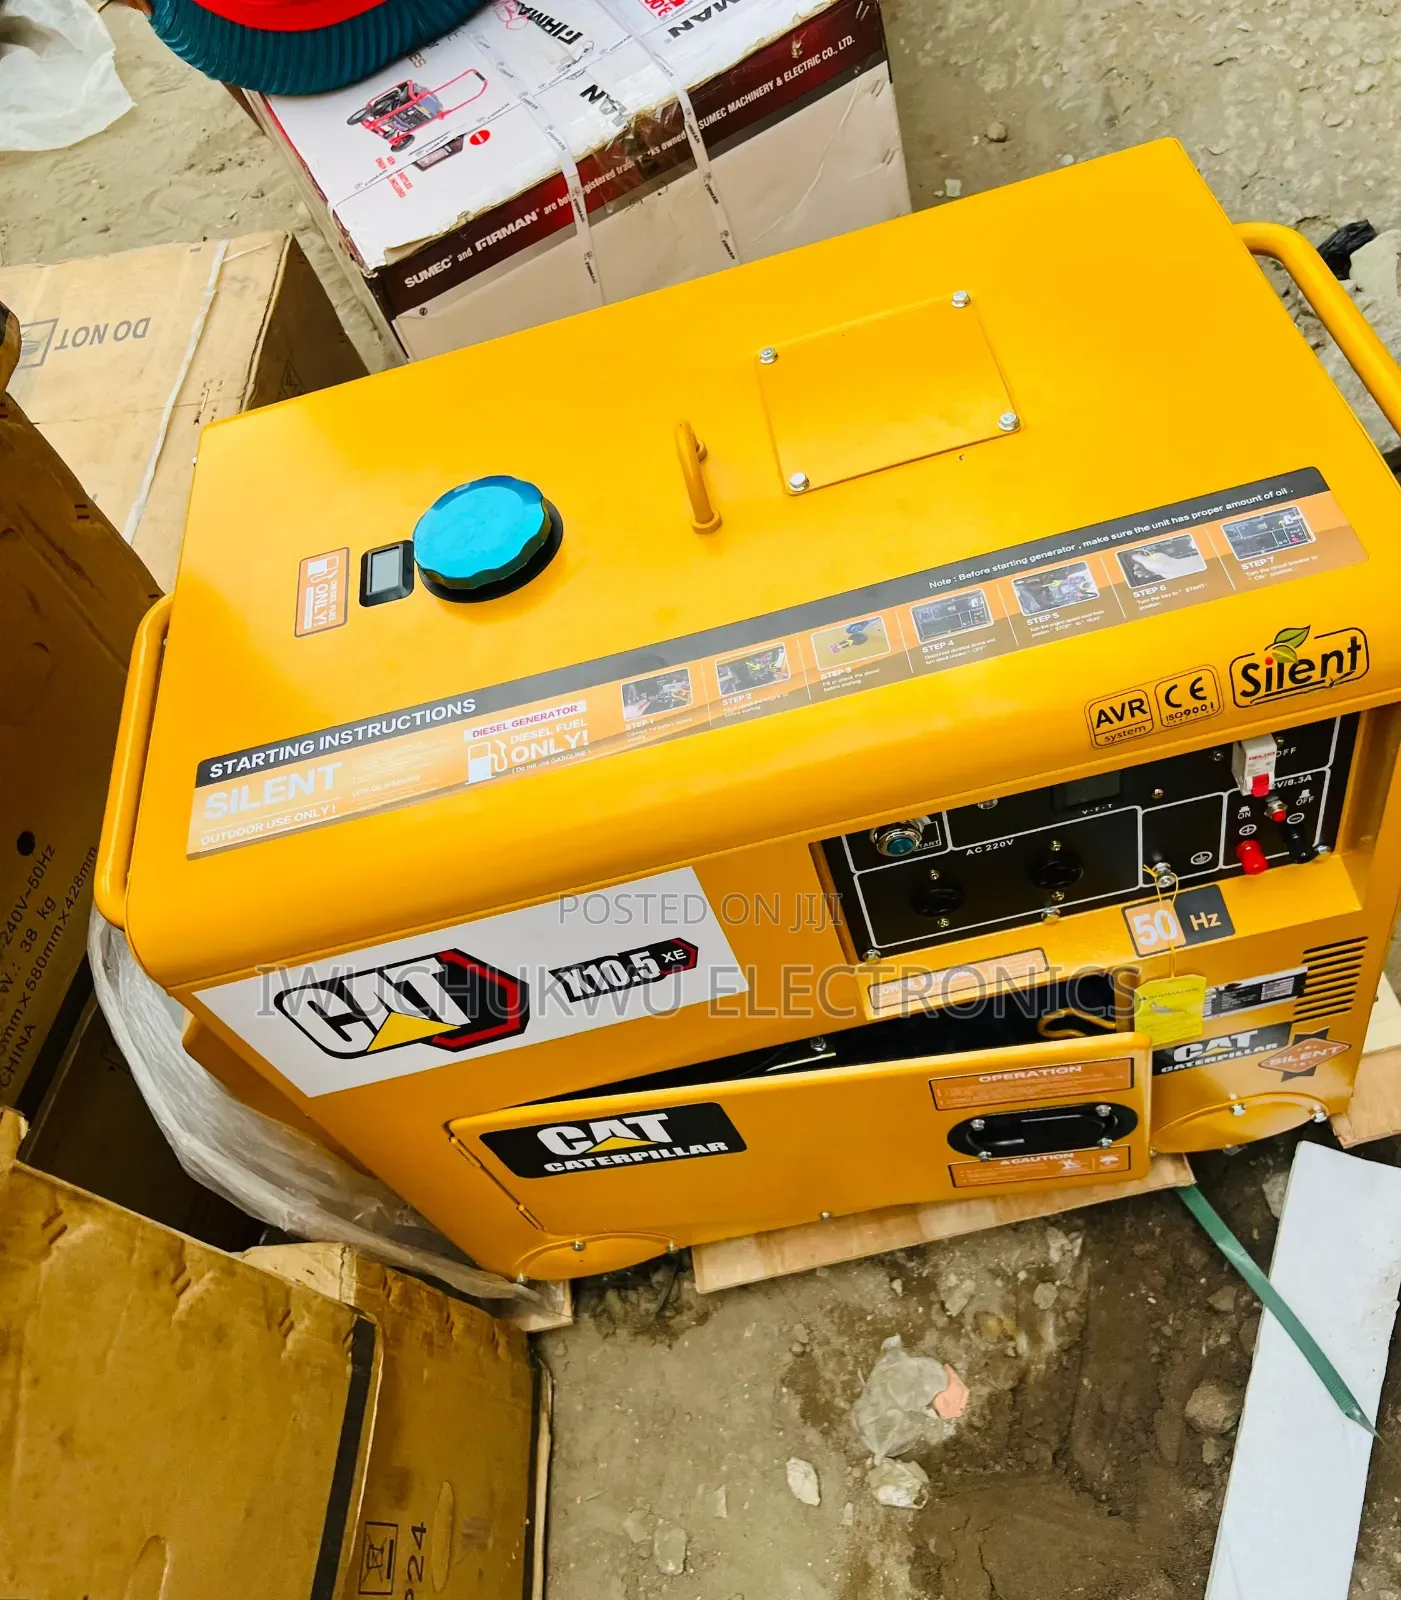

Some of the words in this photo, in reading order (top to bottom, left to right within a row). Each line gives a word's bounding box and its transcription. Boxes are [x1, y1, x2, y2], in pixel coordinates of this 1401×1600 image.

[513, 0, 583, 45] FIRMA
[457, 247, 473, 262] and
[474, 211, 538, 252] FIRMAN
[543, 202, 557, 215] are
[661, 130, 687, 151] owned
[698, 107, 727, 130] SUMEC
[727, 81, 775, 113] MACHINERY
[776, 77, 783, 87] &
[784, 54, 822, 82] ELECTRIC
[838, 35, 855, 51] LTD.
[54, 323, 108, 351] NOT
[113, 317, 151, 342] DO
[929, 577, 952, 589] Note
[959, 567, 991, 582] Before
[992, 557, 1027, 574] starting
[1029, 544, 1076, 563] generator
[1083, 536, 1109, 547] make
[1111, 530, 1133, 540] sure
[1134, 525, 1150, 534] the
[1151, 519, 1170, 530] unit
[1171, 514, 1190, 524] has
[1192, 505, 1223, 520] proper
[1225, 495, 1263, 510] amount
[1264, 491, 1274, 500] of
[1275, 488, 1288, 497] oil
[1241, 558, 1266, 570] STEP
[1268, 556, 1275, 564] 7
[313, 583, 329, 627] ONLY!
[1133, 587, 1158, 599] STEP
[1159, 584, 1166, 592] 6
[1026, 615, 1051, 626] STEP
[1052, 612, 1059, 620] 5
[922, 642, 946, 654] STEP
[821, 668, 843, 680] STEP
[1240, 636, 1362, 698] Silent
[722, 695, 744, 706] STEP
[1095, 697, 1149, 729] AVR
[1166, 702, 1215, 722] ISO9001
[472, 723, 509, 739] DIESEL
[511, 704, 578, 728] GENERATOR
[510, 727, 554, 745] DIESEL
[555, 718, 589, 733] FUEL
[625, 721, 648, 731] STEP
[1104, 723, 1147, 743] system
[209, 740, 314, 778] STARTING
[319, 698, 476, 750] INSTRUCTIONS
[511, 729, 589, 764] ONLY!
[203, 762, 342, 820] SILENT
[1296, 795, 1315, 807] OFF
[201, 823, 263, 846] OUTDOOR
[267, 814, 291, 830] USE
[1237, 811, 1251, 820] ON
[917, 840, 940, 850] TART
[966, 845, 983, 857] AC
[985, 839, 1015, 853] 220V
[19, 928, 39, 954] 38
[36, 895, 57, 921] kg
[1133, 910, 1179, 946] 50
[1190, 911, 1222, 931] Hz
[560, 951, 660, 998] X10.5
[661, 949, 687, 963] XE
[281, 955, 471, 1053] CAT
[0, 1023, 37, 1088] CHINA
[1161, 1043, 1278, 1073] CATERPILLAR
[1173, 1030, 1258, 1062] CAT
[1269, 1045, 1341, 1066] SILENT
[978, 1065, 1082, 1083] OPERATION
[537, 1113, 673, 1156] CAT
[544, 1141, 729, 1173] CATERPILLAR
[1009, 1153, 1074, 1165] CAUTION
